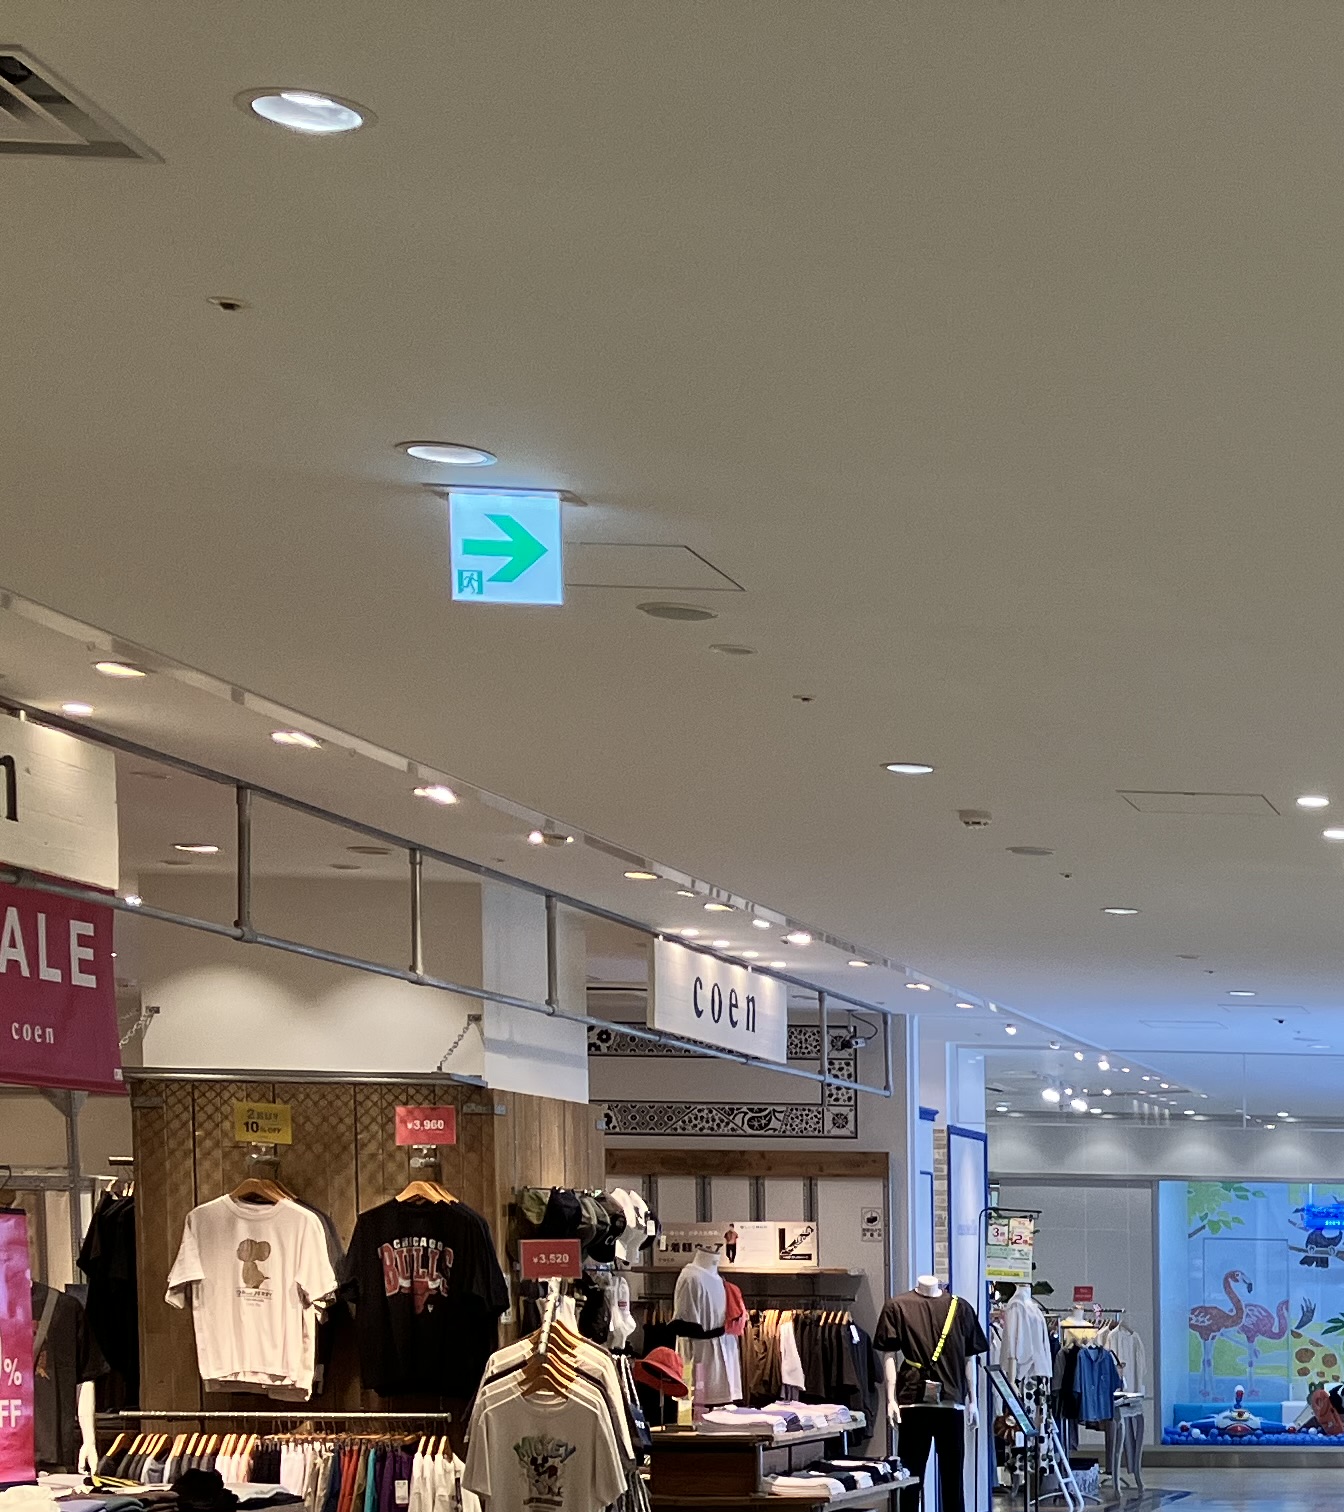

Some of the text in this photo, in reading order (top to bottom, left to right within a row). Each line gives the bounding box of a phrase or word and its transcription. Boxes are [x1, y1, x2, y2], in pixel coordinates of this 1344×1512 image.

[693, 976, 756, 1033] coen
[11, 1022, 55, 1044] coen
[393, 1237, 444, 1251] CHICAGO
[377, 1242, 454, 1297] BULLS
[532, 1253, 570, 1264] ¥3,520
